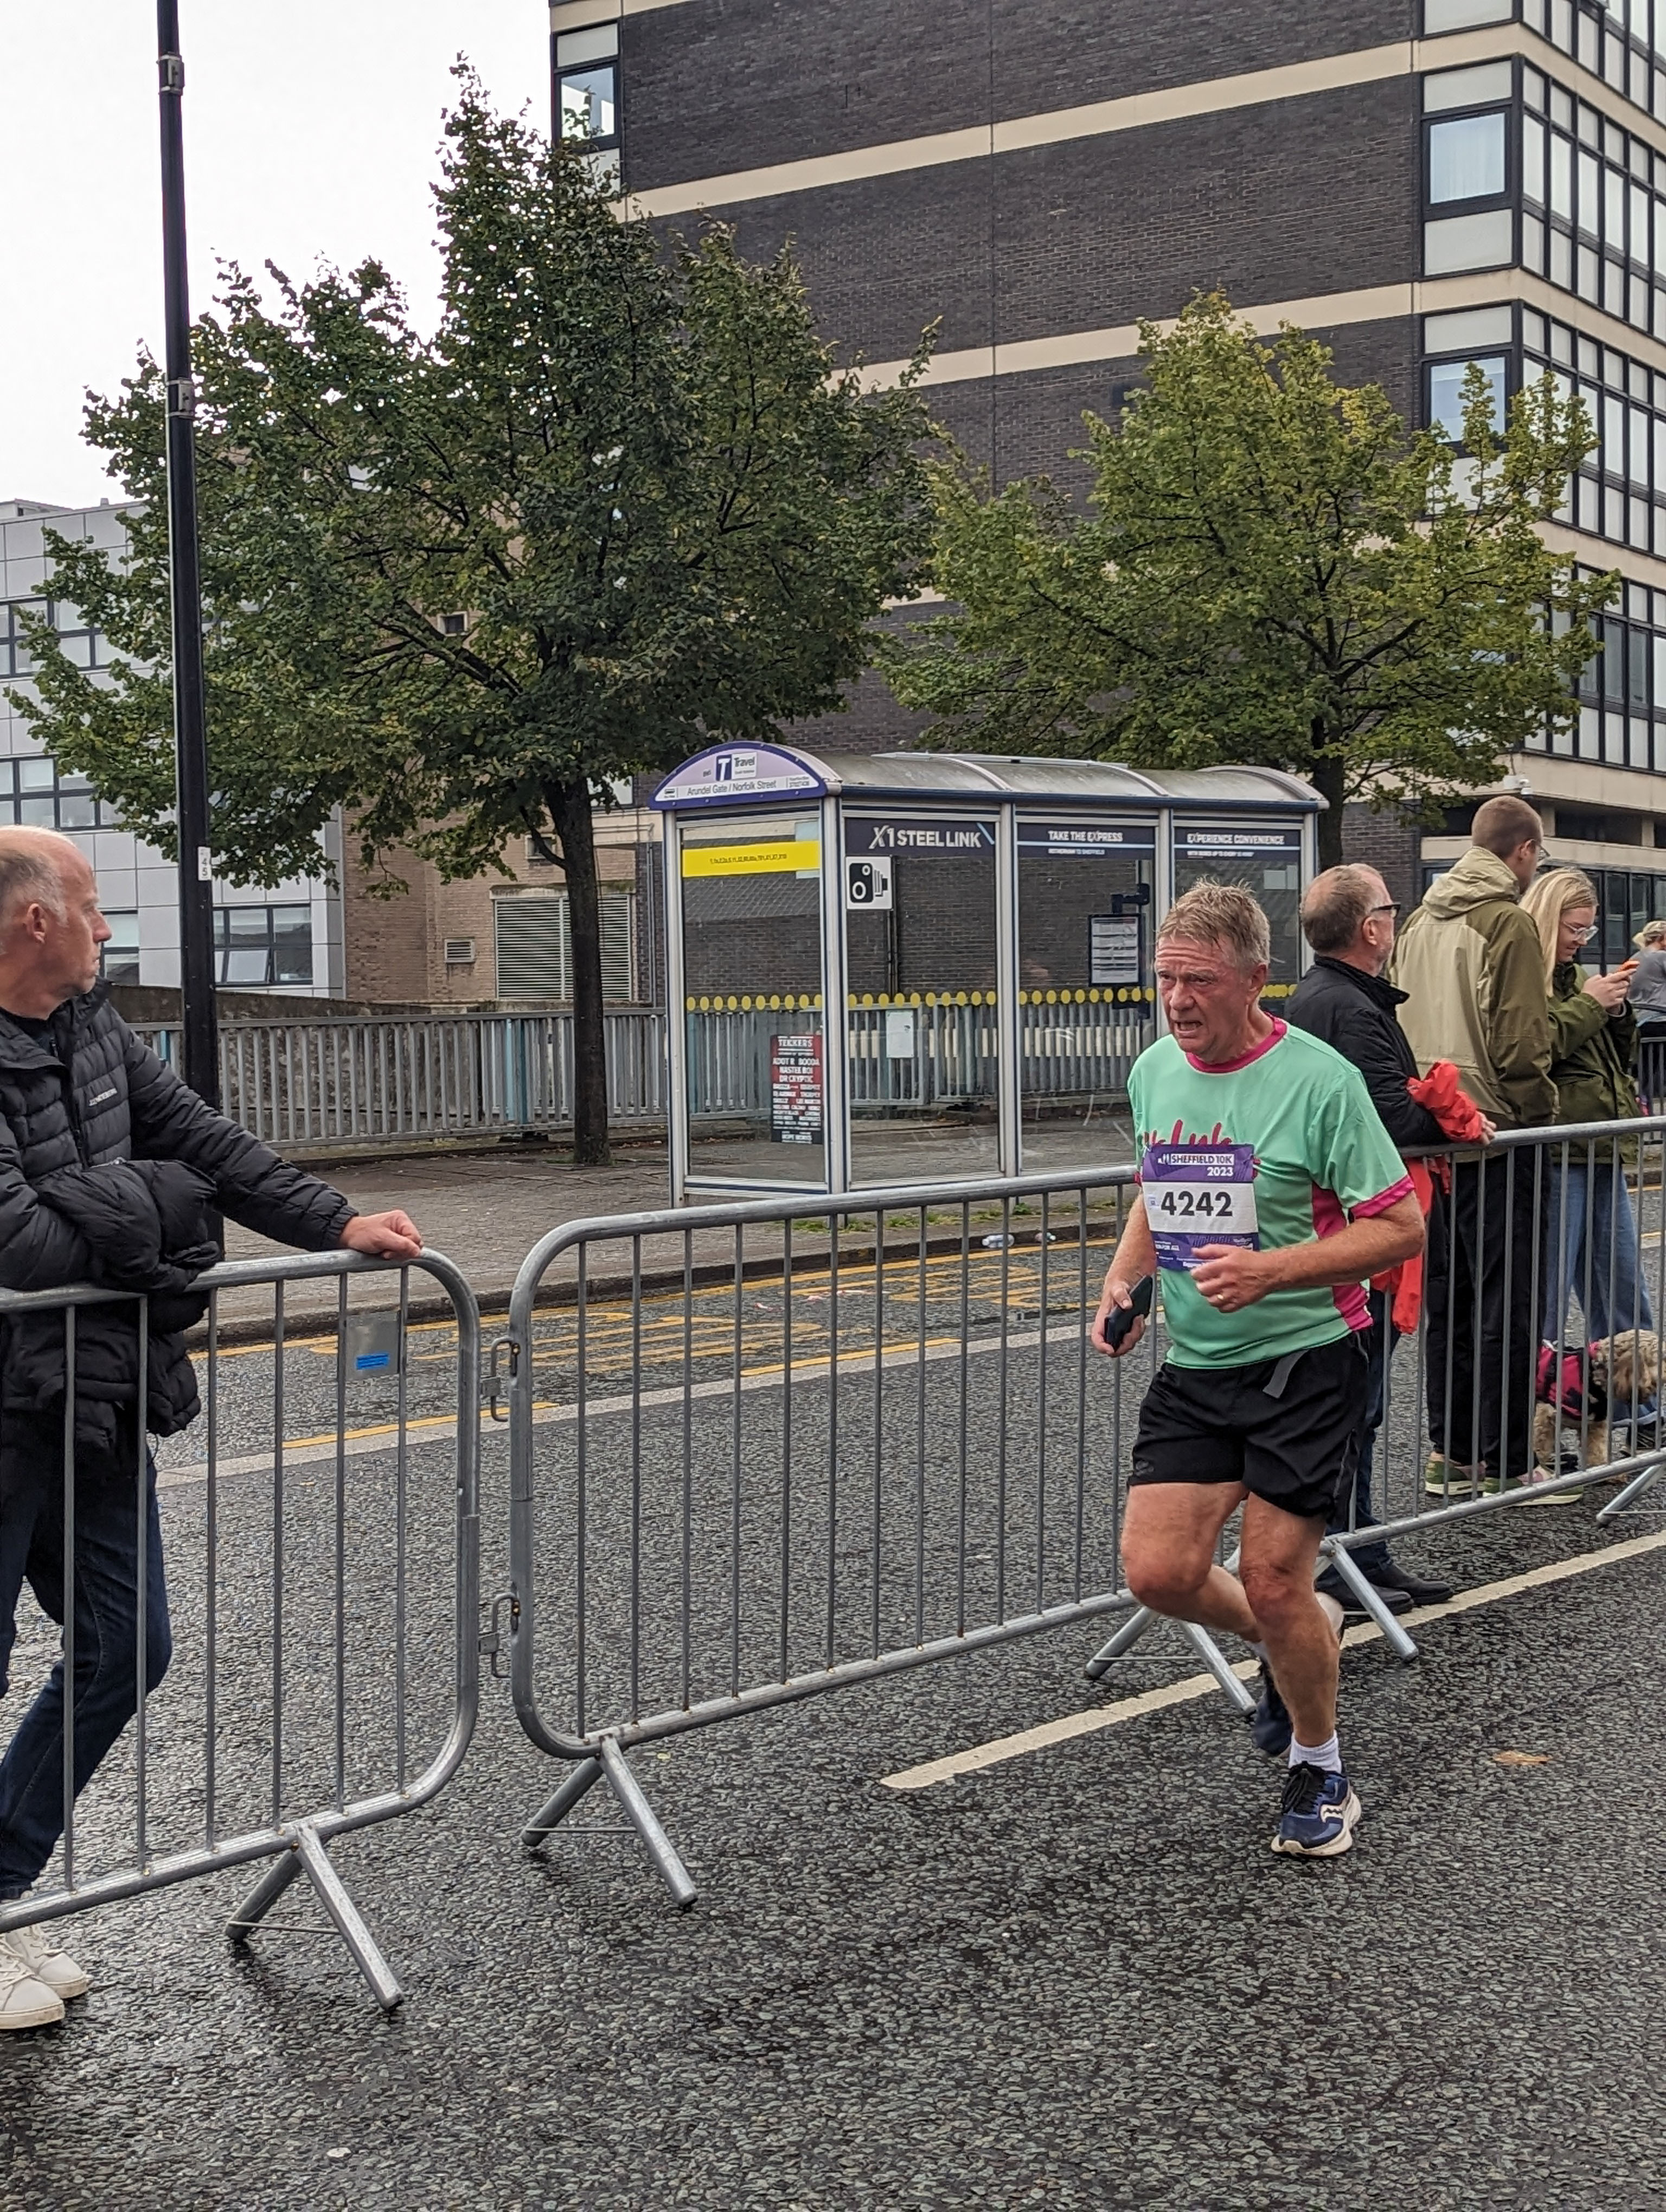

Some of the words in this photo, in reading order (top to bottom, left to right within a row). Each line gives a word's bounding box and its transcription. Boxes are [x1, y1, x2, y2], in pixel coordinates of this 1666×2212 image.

[734, 757, 755, 767] Travel
[687, 785, 711, 795] Arundel
[712, 784, 728, 793] Gate
[732, 782, 756, 792] Norfolk
[757, 780, 777, 789] Street
[868, 825, 895, 850] X1
[896, 829, 945, 847] STEEL
[946, 831, 982, 848] LINK
[1048, 830, 1069, 840] TAKE
[1069, 831, 1086, 841] THE
[1087, 830, 1123, 843] EXPRESS
[1171, 1154, 1215, 1164] SHEFFIELD
[1215, 1155, 1233, 1164] 10K
[1207, 1166, 1234, 1177] 2023
[1161, 1191, 1233, 1217] 4242
